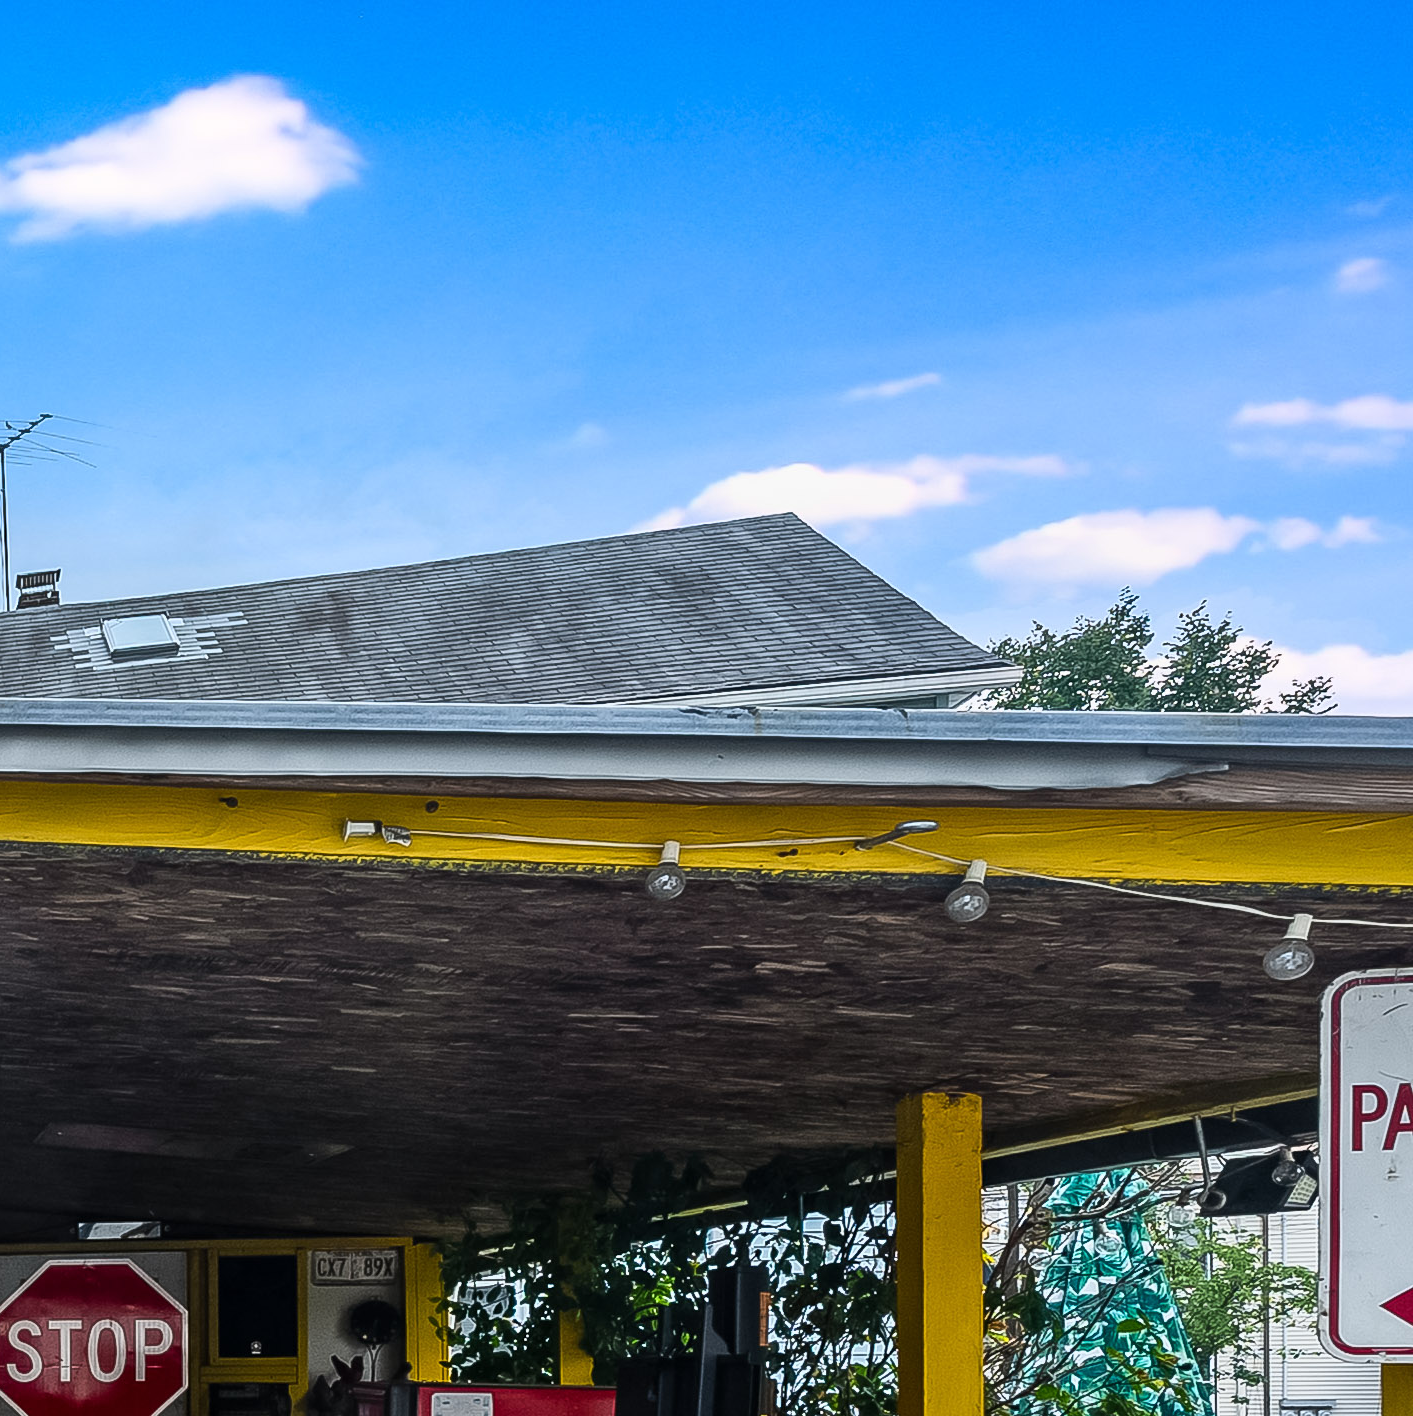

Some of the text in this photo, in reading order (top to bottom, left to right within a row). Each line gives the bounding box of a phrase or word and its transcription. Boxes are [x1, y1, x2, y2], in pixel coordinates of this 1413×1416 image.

[1351, 1082, 1413, 1152] PA
[317, 1257, 394, 1277] CX7 89X
[5, 1318, 175, 1384] STOP
